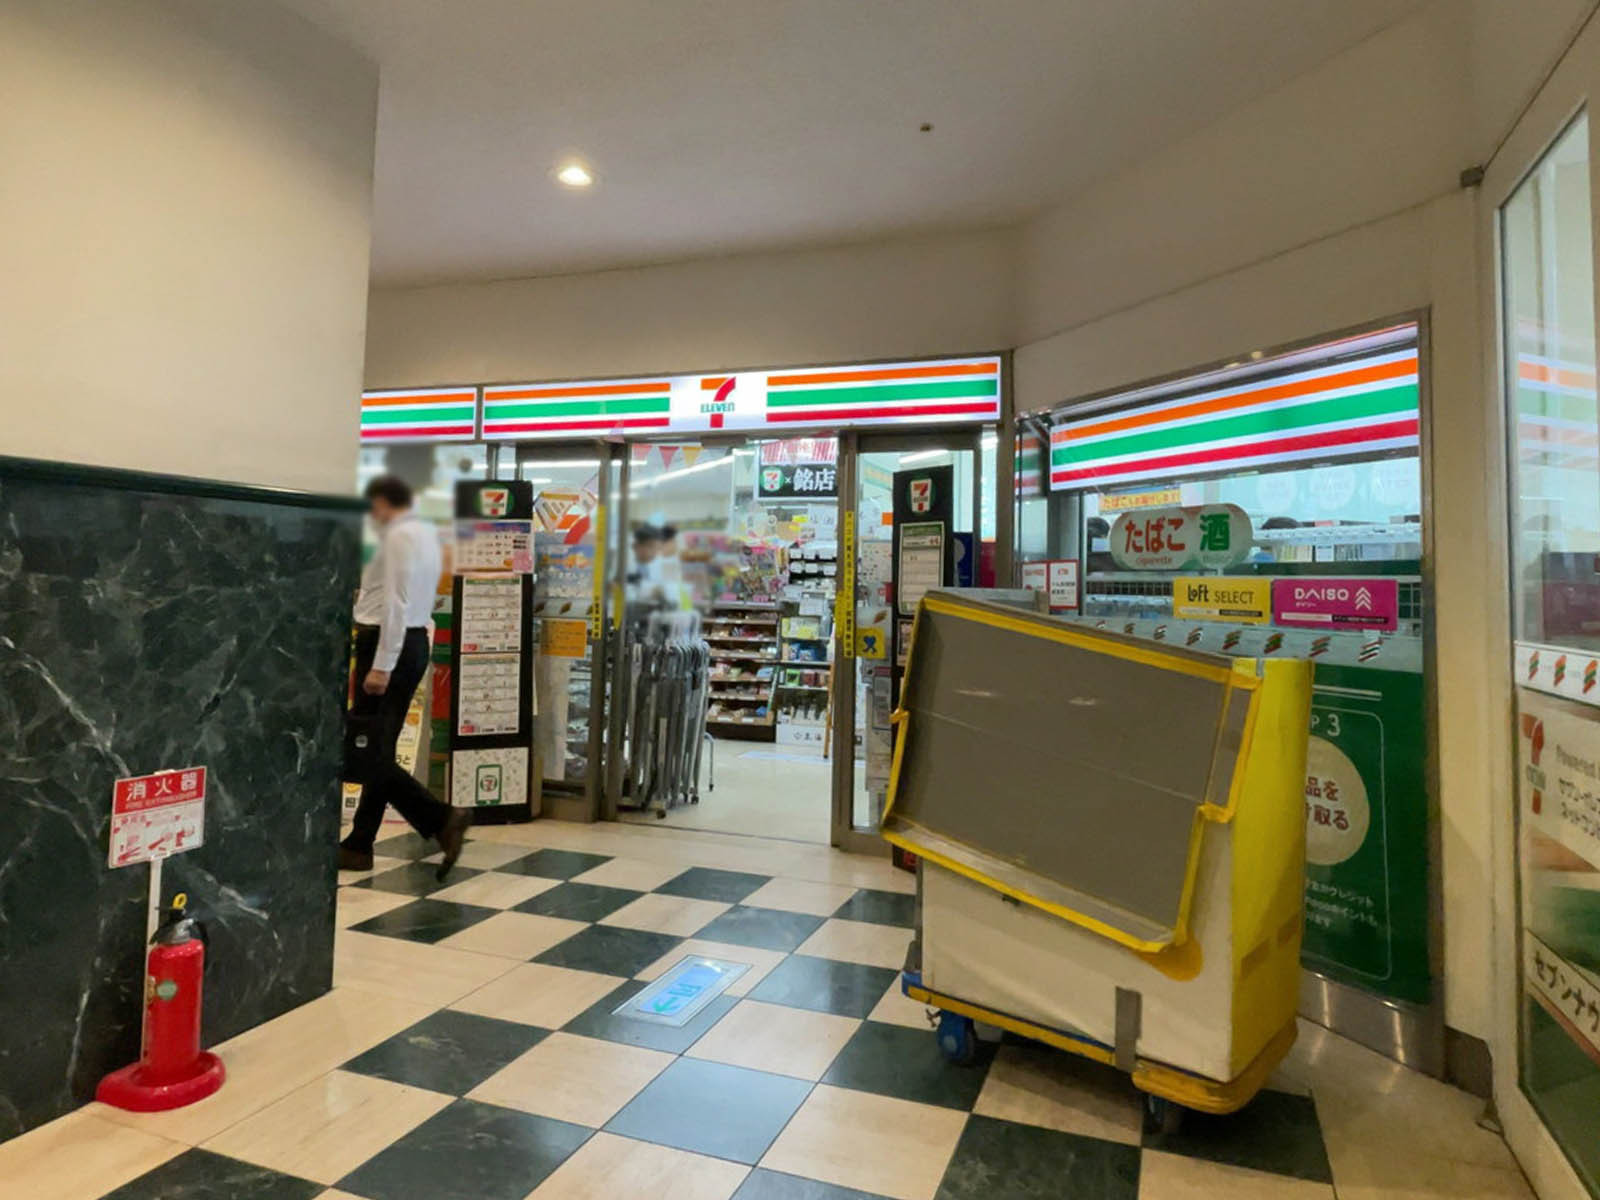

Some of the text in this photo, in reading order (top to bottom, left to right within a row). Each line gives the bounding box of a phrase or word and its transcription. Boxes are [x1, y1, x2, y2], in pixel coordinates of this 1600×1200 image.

[701, 376, 737, 428] 7
[793, 468, 836, 491] 銘店
[1125, 513, 1230, 553] たばこ 酒
[1214, 590, 1255, 605] SELECT
[1294, 587, 1349, 601] DAISO
[1327, 713, 1341, 737] 3
[126, 771, 197, 801] 消火器
[1306, 776, 1339, 801] 品を
